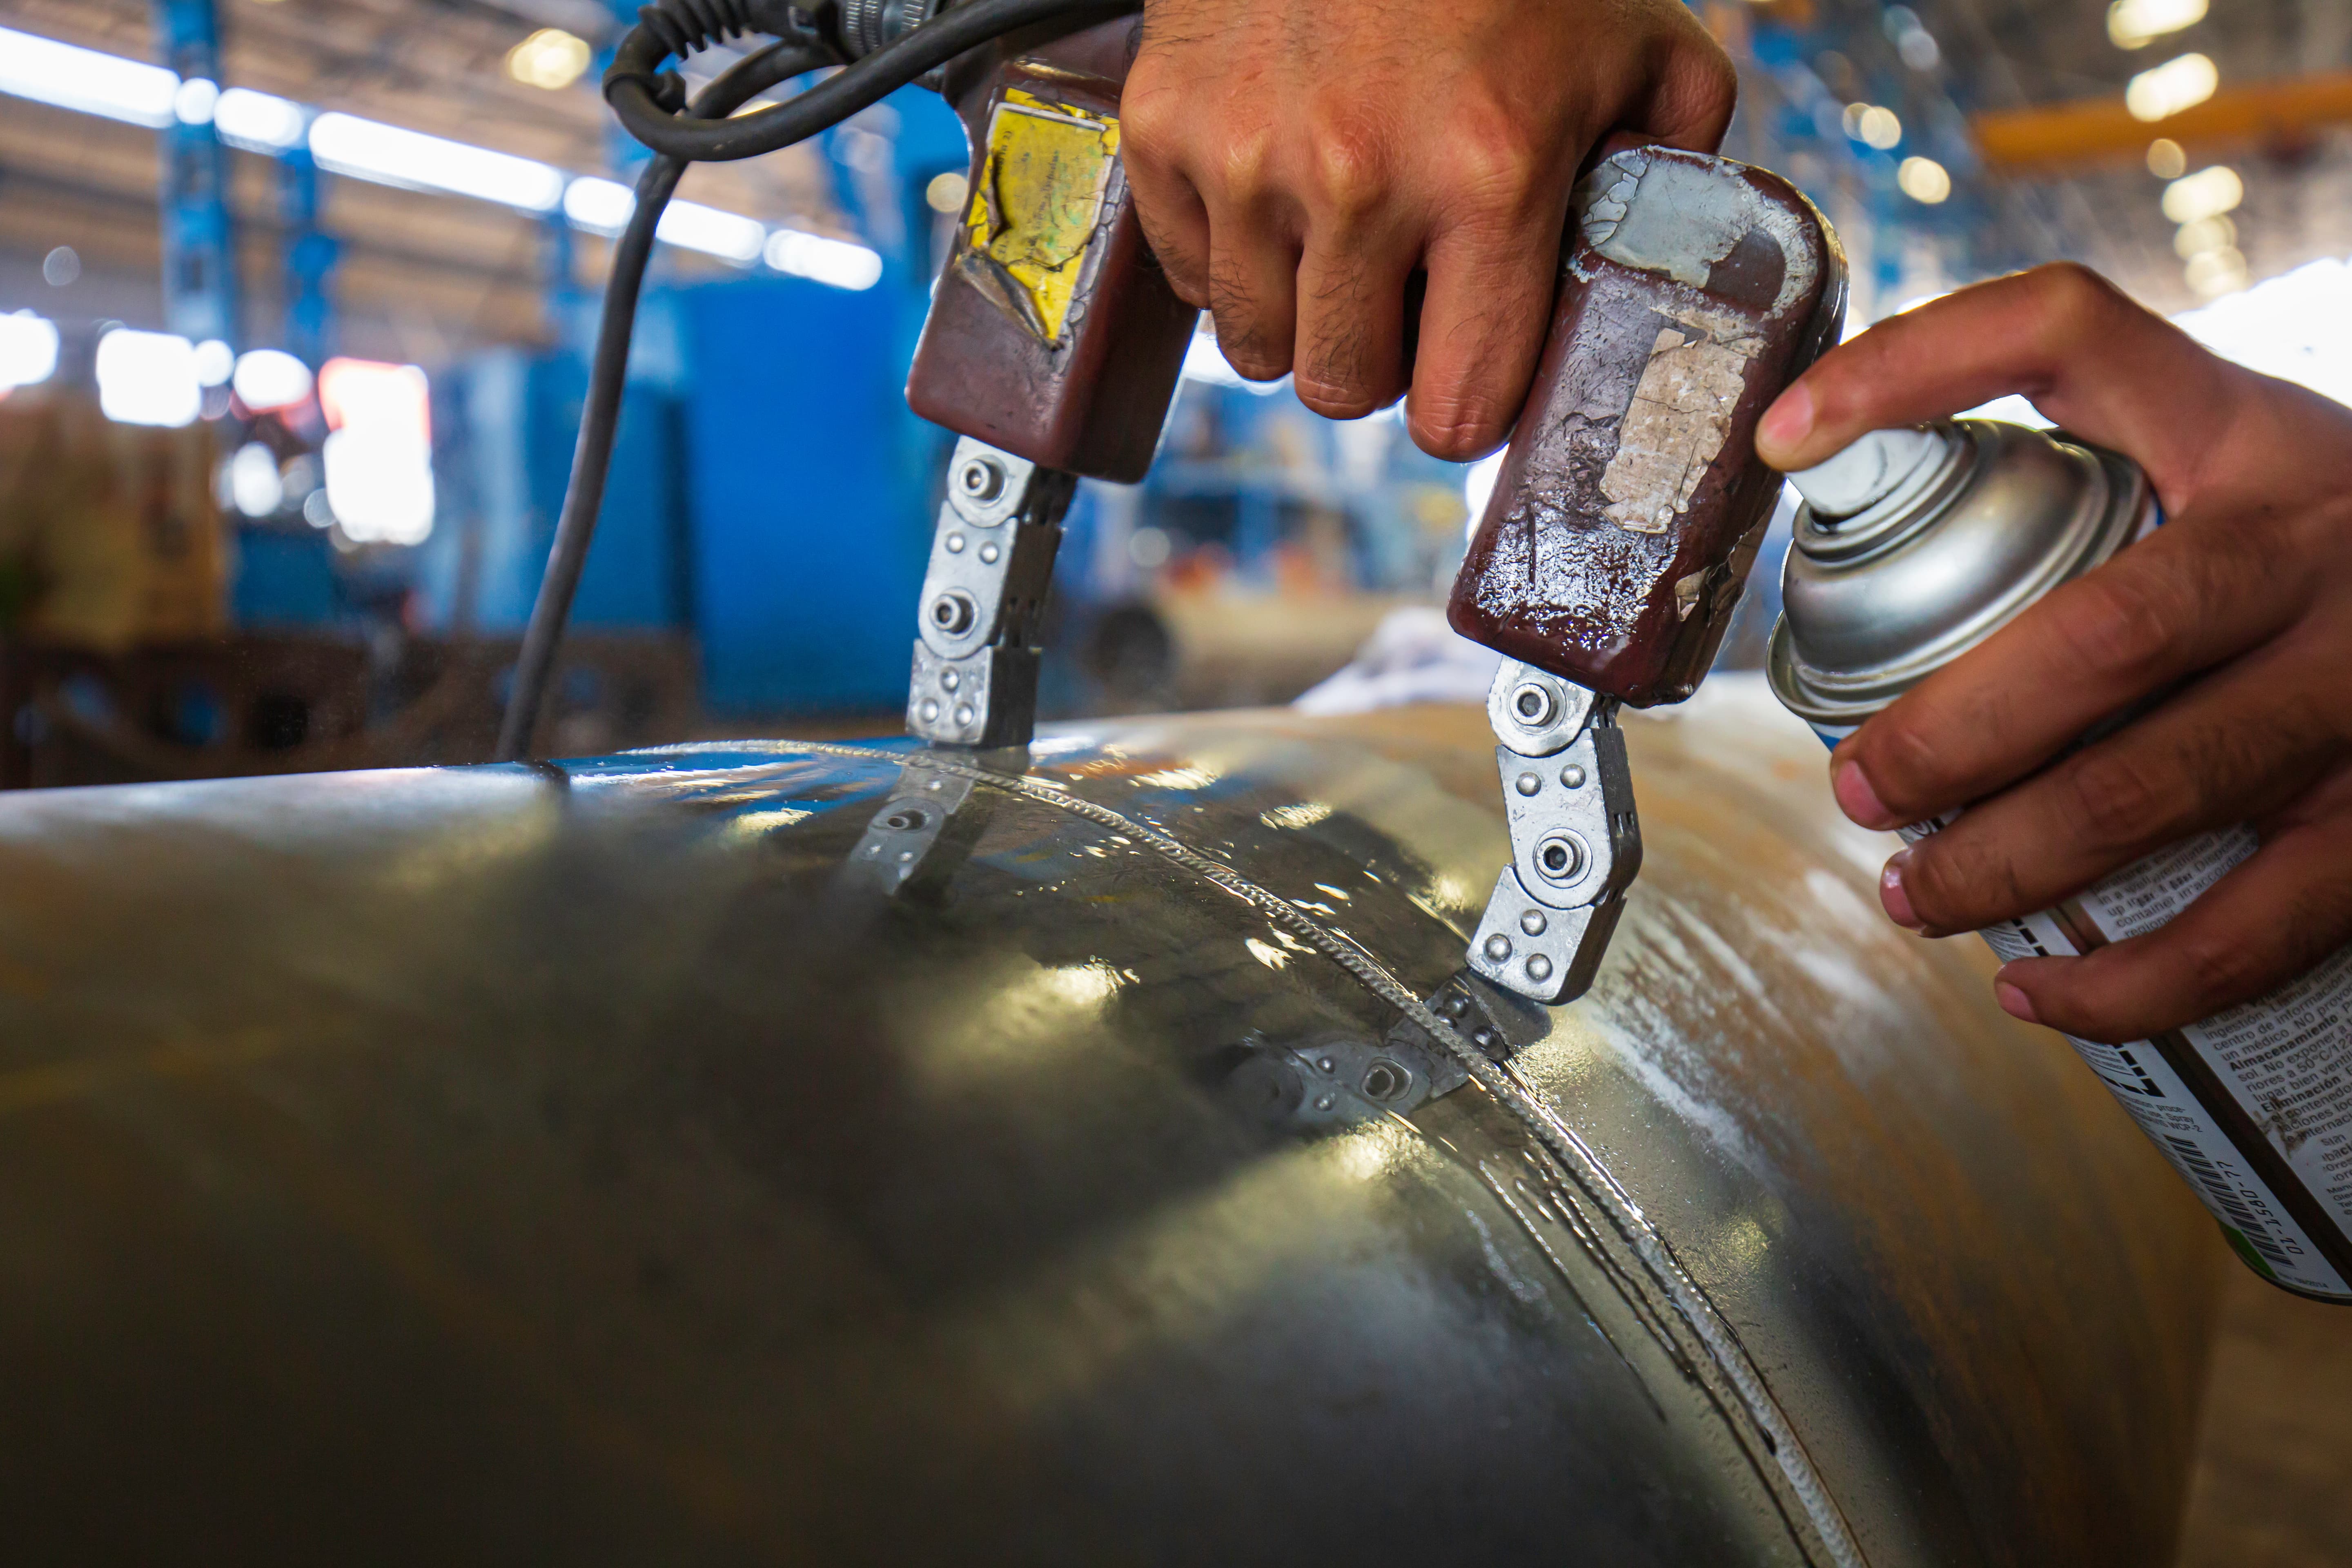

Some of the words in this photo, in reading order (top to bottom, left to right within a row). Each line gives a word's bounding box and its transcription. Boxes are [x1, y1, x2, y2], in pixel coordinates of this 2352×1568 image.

[2107, 905, 2125, 917] up
[2116, 895, 2176, 928] container
[2213, 1031, 2255, 1051] centro
[2258, 1022, 2274, 1034] de
[2276, 972, 2345, 1025] información
[2220, 1051, 2240, 1061] un
[2294, 1012, 2315, 1029] NO
[2263, 1061, 2284, 1073] No
[2287, 1031, 2336, 1063] exponer
[2338, 1025, 2347, 1035] a
[2245, 1075, 2285, 1092] riores
[2287, 1070, 2297, 1078] a
[2289, 1073, 2319, 1090] bien
[2165, 1113, 2194, 1124] Spray
[2167, 1122, 2203, 1132] WCP-2
[2216, 1161, 2305, 1256] 01-1580-77
